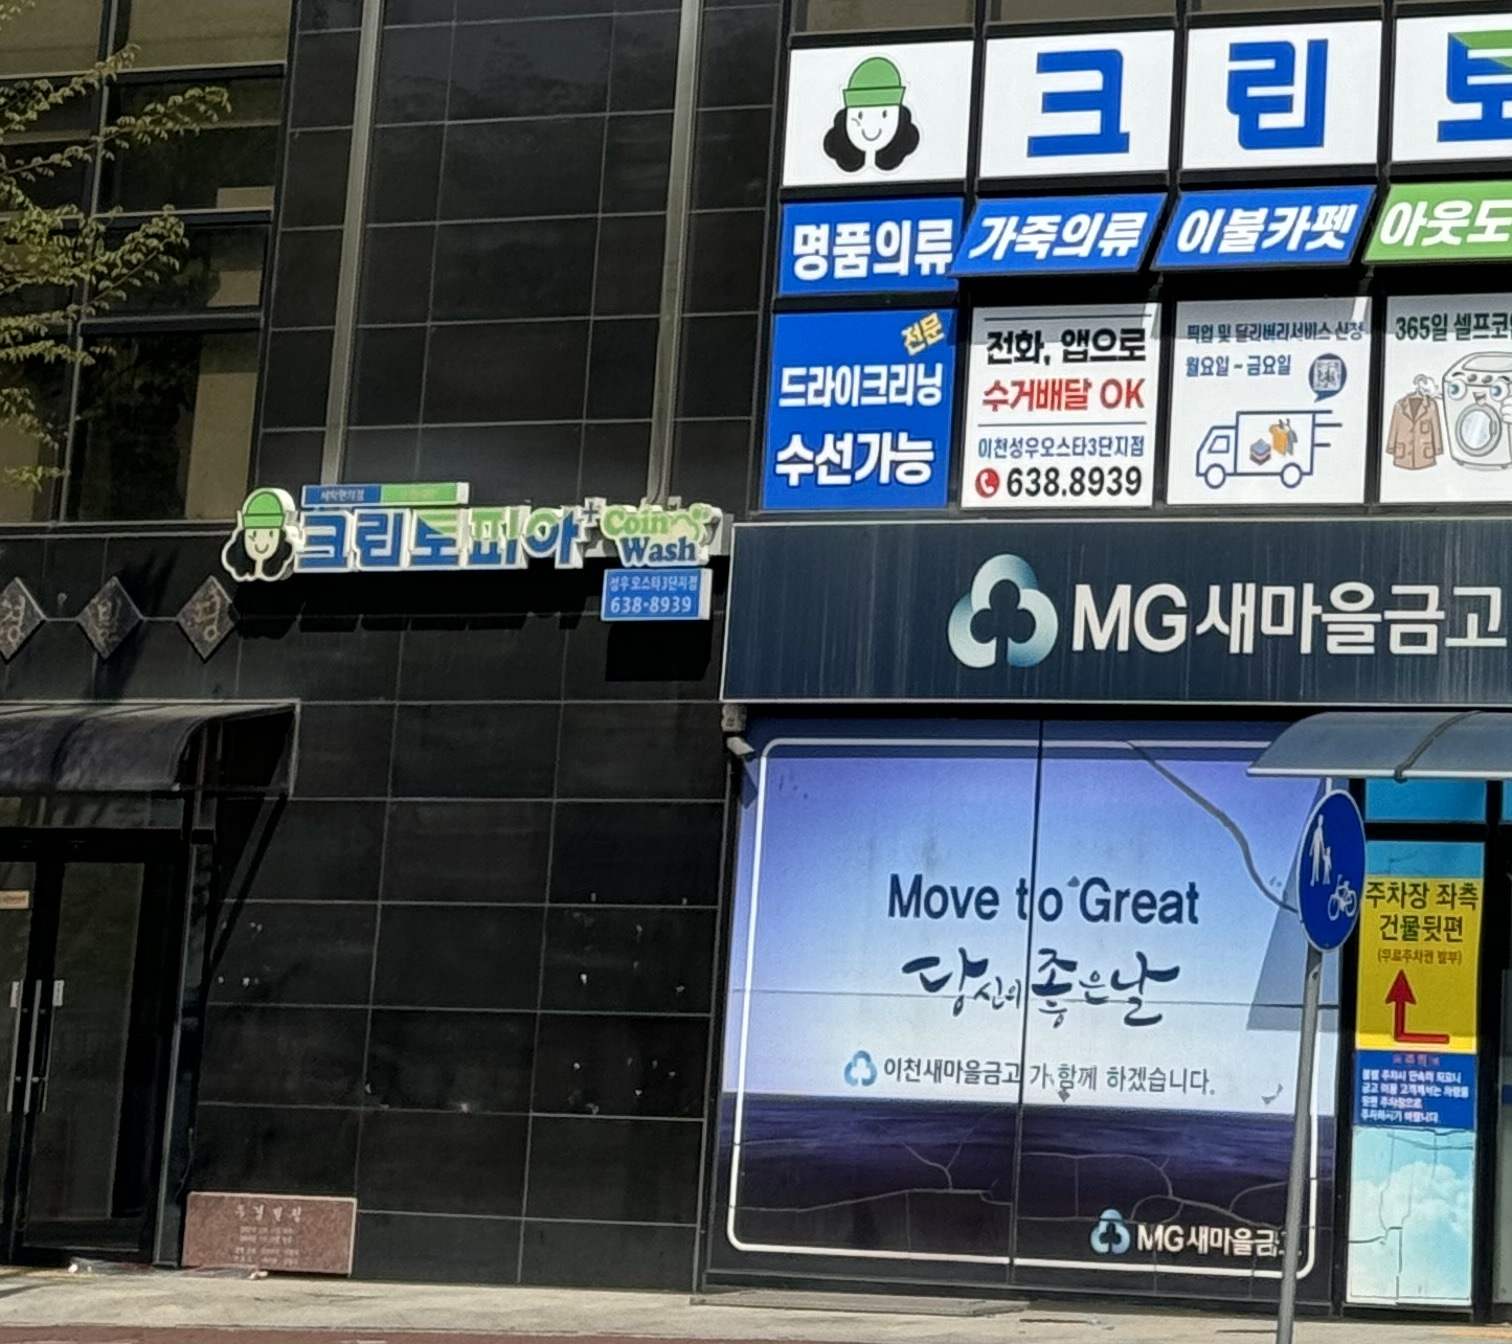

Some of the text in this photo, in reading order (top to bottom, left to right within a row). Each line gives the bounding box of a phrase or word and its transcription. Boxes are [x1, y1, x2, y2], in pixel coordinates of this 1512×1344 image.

[792, 218, 954, 281] 명품의류
[968, 211, 1148, 261] 가죽의류
[1176, 203, 1359, 254] 이불카펫
[901, 311, 946, 357] 전문
[1394, 313, 1449, 343] 365일
[985, 327, 1147, 366] 전화, 앱으로
[1186, 355, 1229, 378] 월요일
[1247, 354, 1292, 377] 금요일
[778, 362, 943, 408] 드라이크리닝
[982, 377, 1145, 412] 수거배달 OK
[775, 431, 935, 487] 수선가능
[977, 434, 1145, 460] 이천성우오스타3단지점
[1006, 466, 1143, 498] 638.8939
[302, 506, 581, 570] 크린토피아
[604, 508, 669, 536] Coin
[618, 535, 697, 564] Wash
[610, 596, 692, 614] 638-8939
[1072, 582, 1508, 656] MG새마을금고
[888, 872, 1200, 926] Move to Great
[1365, 881, 1479, 911] 주차장 좌측
[1379, 913, 1464, 943] 건물뒷편
[902, 946, 1021, 1018] 당신의
[1057, 1062, 1098, 1093] 함께
[1106, 1065, 1217, 1096] 하겠습니다.
[1136, 1223, 1286, 1258] MG새마을금
